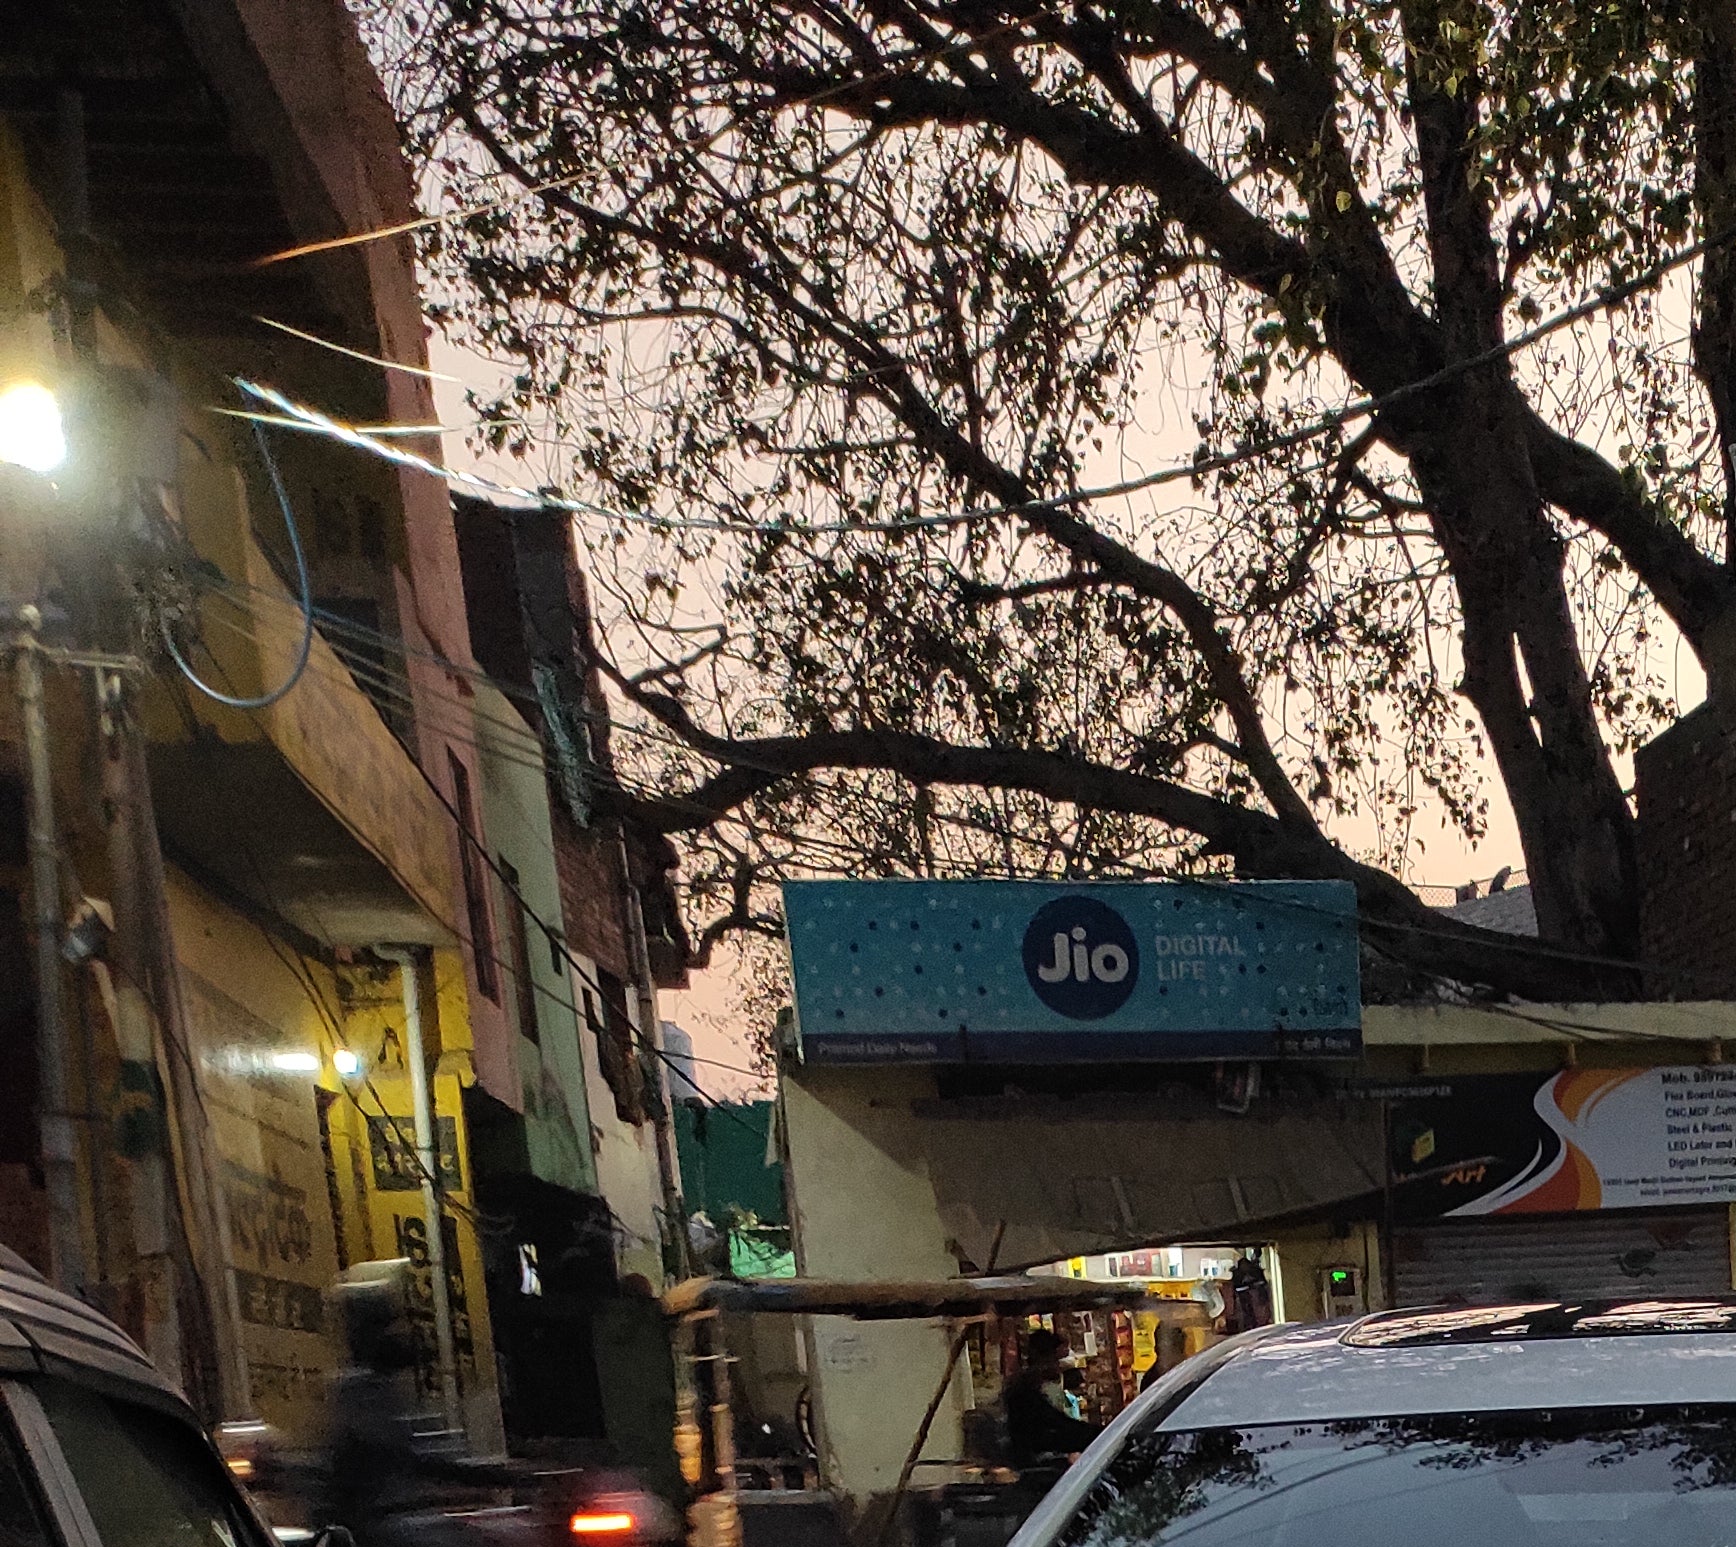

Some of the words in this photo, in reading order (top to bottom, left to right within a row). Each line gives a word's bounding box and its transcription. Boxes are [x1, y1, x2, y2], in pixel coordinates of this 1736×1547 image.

[1155, 934, 1247, 957] DIGITAL
[1038, 926, 1130, 984] Jio
[1156, 959, 1207, 981] LIFE
[1693, 1123, 1700, 1134] &
[1667, 1140, 1688, 1152] LED
[1715, 1138, 1733, 1150] and
[1669, 1157, 1699, 1170] Digital
